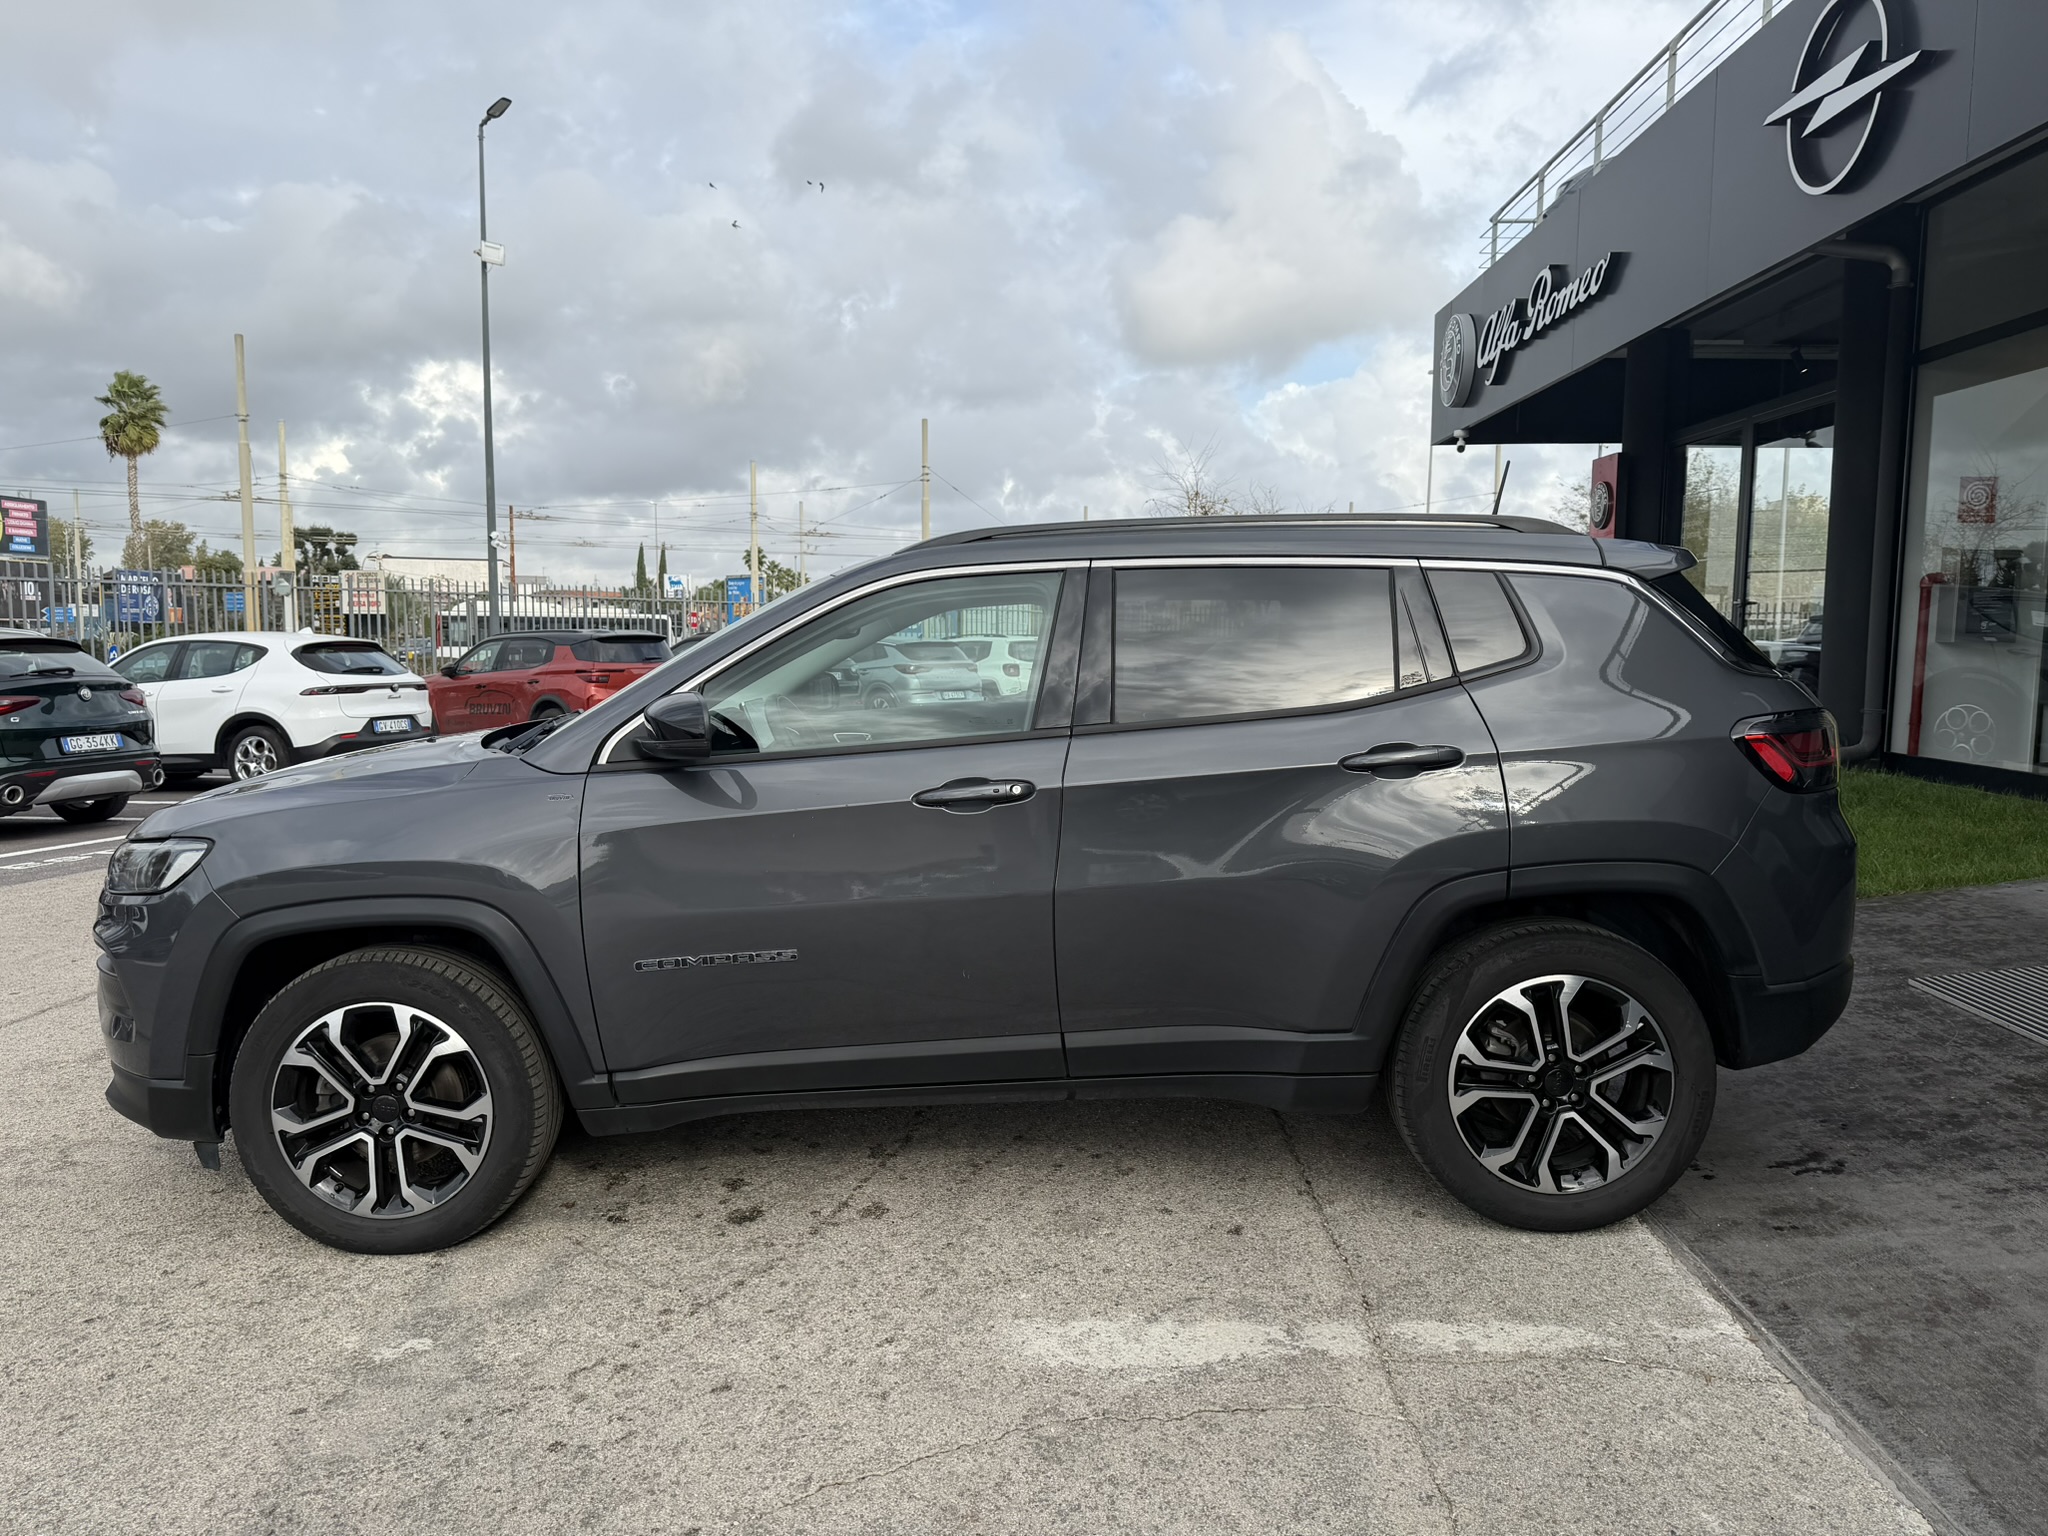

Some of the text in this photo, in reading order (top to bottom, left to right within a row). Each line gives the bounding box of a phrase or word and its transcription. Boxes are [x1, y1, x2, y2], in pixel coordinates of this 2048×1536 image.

[1476, 252, 1612, 386] Alfa Romeo
[633, 949, 798, 973] COMPASS
